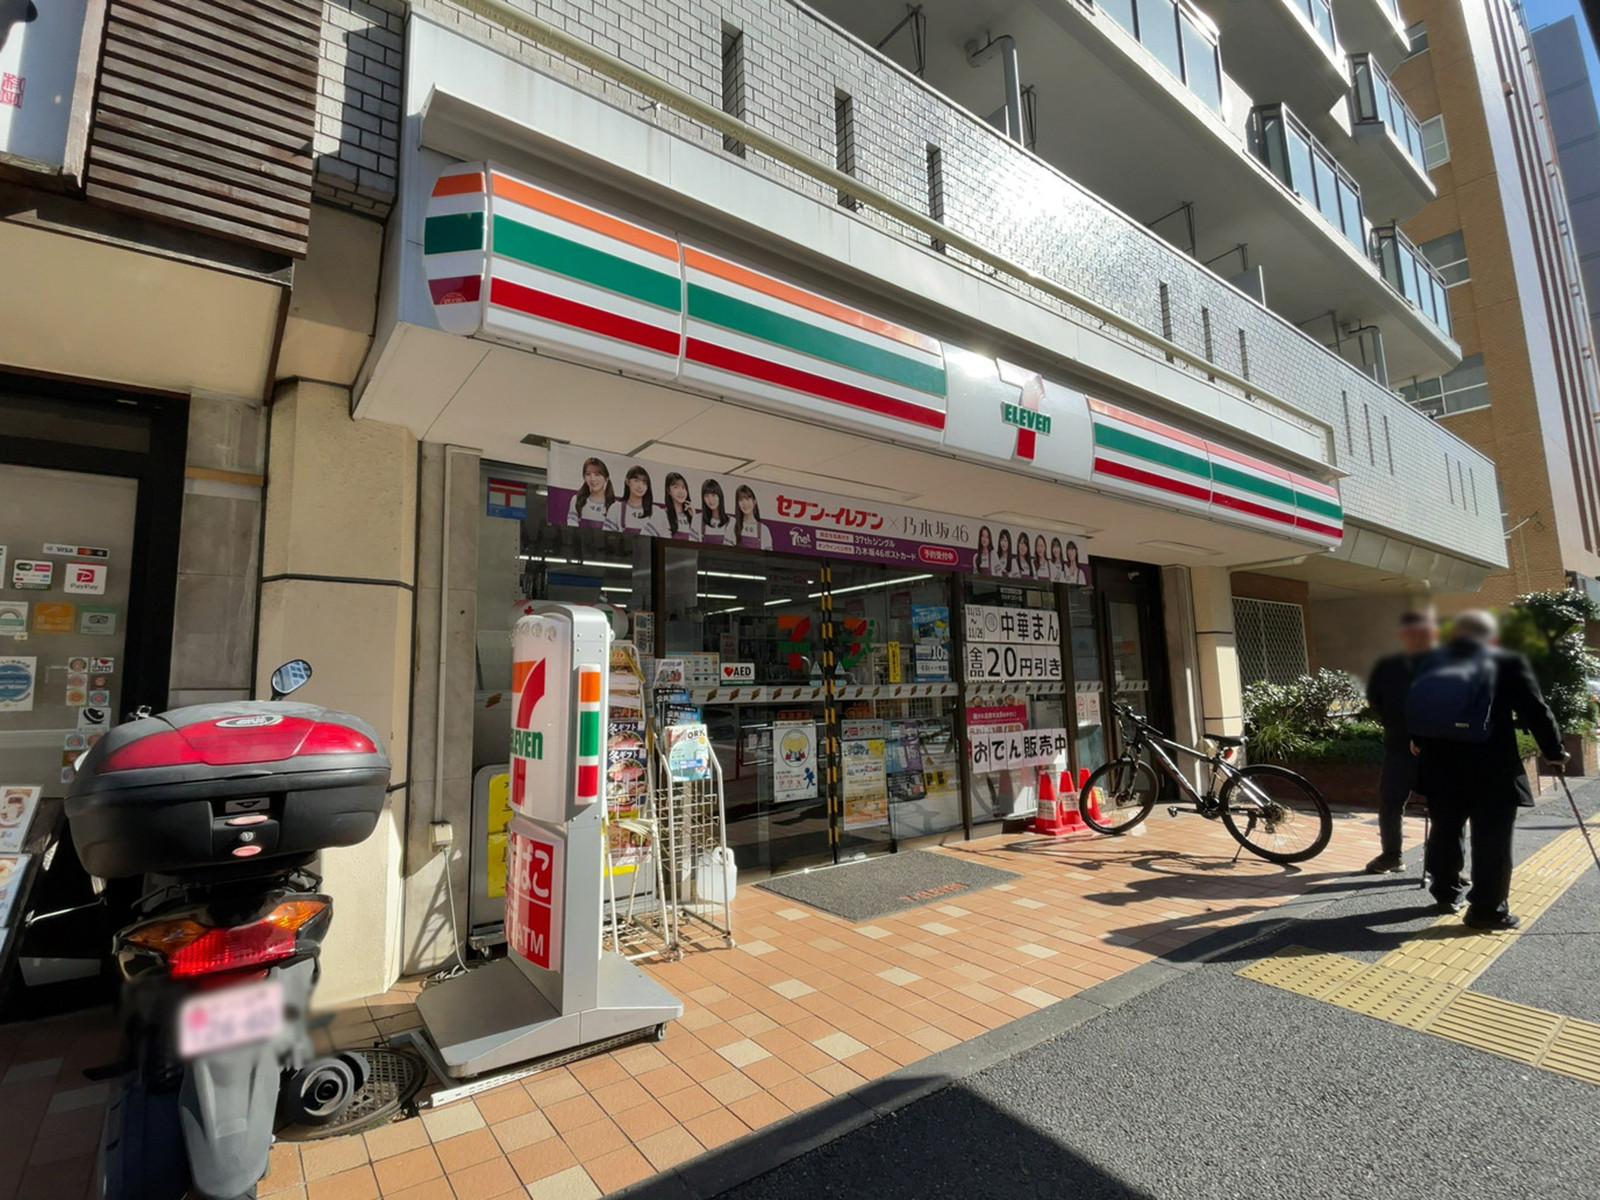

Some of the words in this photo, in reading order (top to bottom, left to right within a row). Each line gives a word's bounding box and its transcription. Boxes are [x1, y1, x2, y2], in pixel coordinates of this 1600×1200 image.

[903, 516, 969, 543] 乃木坂46
[854, 535, 895, 548] 37thシングル
[855, 546, 917, 561] 乃木坂46ポストカード
[1000, 611, 1059, 642] 中華まん
[733, 666, 752, 677] AED
[608, 722, 637, 735] 冬ギフト
[974, 733, 1067, 764] おでん販売中
[609, 749, 638, 763] 冬ギフト
